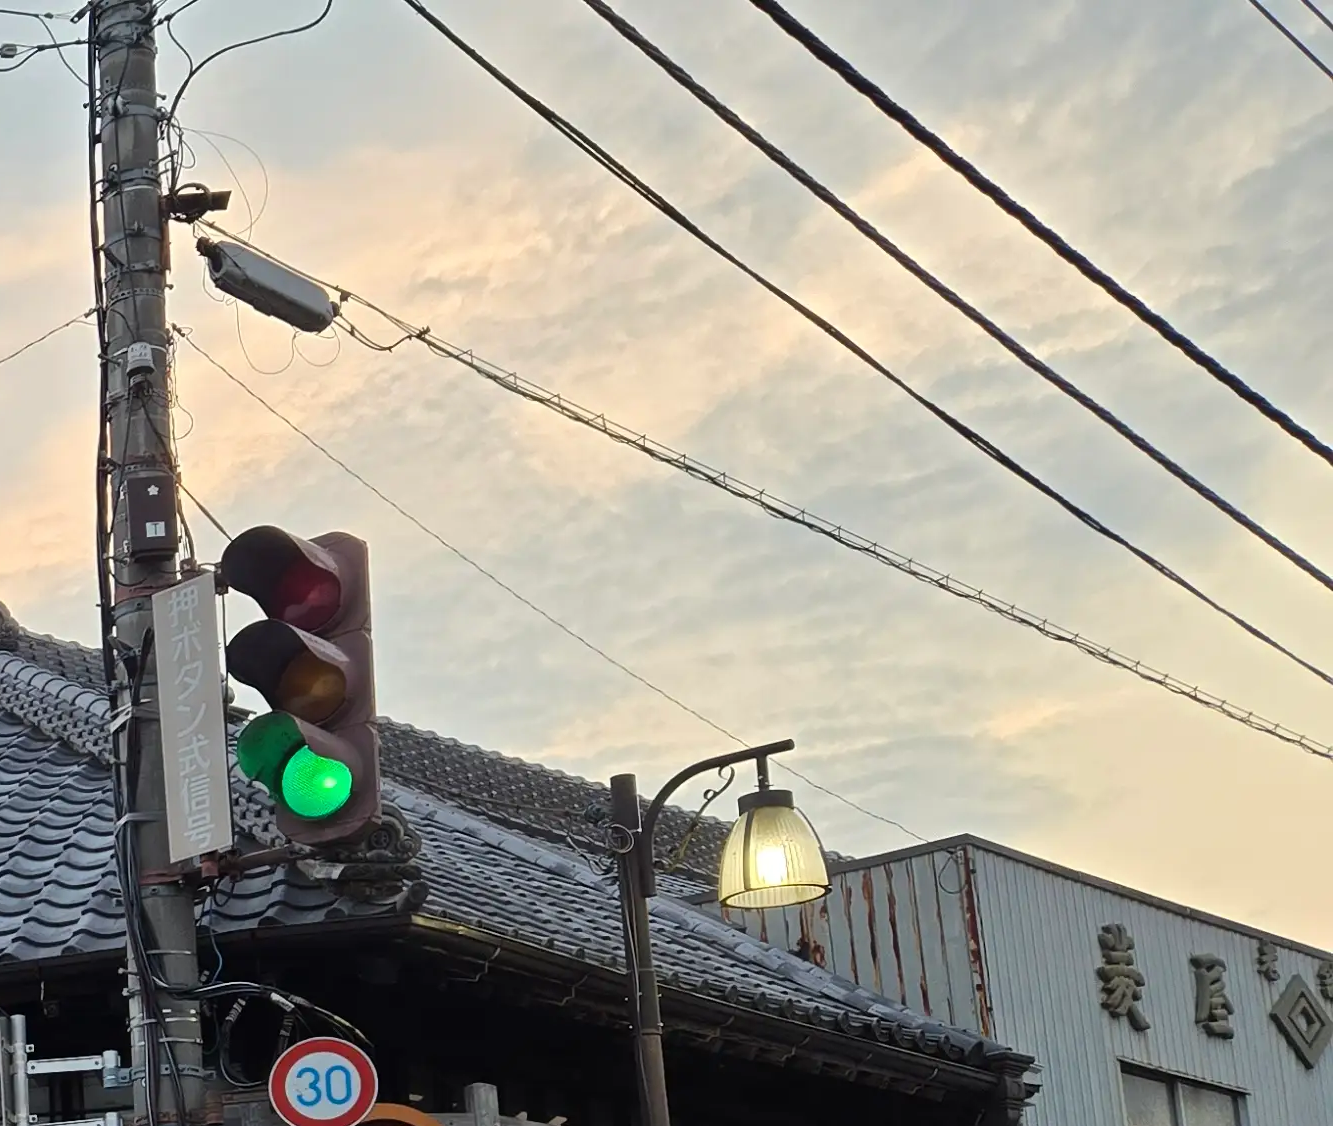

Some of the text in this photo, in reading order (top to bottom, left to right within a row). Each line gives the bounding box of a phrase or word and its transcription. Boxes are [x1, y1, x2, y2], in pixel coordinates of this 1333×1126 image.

[168, 584, 215, 849] 押ボタン式信号
[296, 1064, 352, 1107] 30
